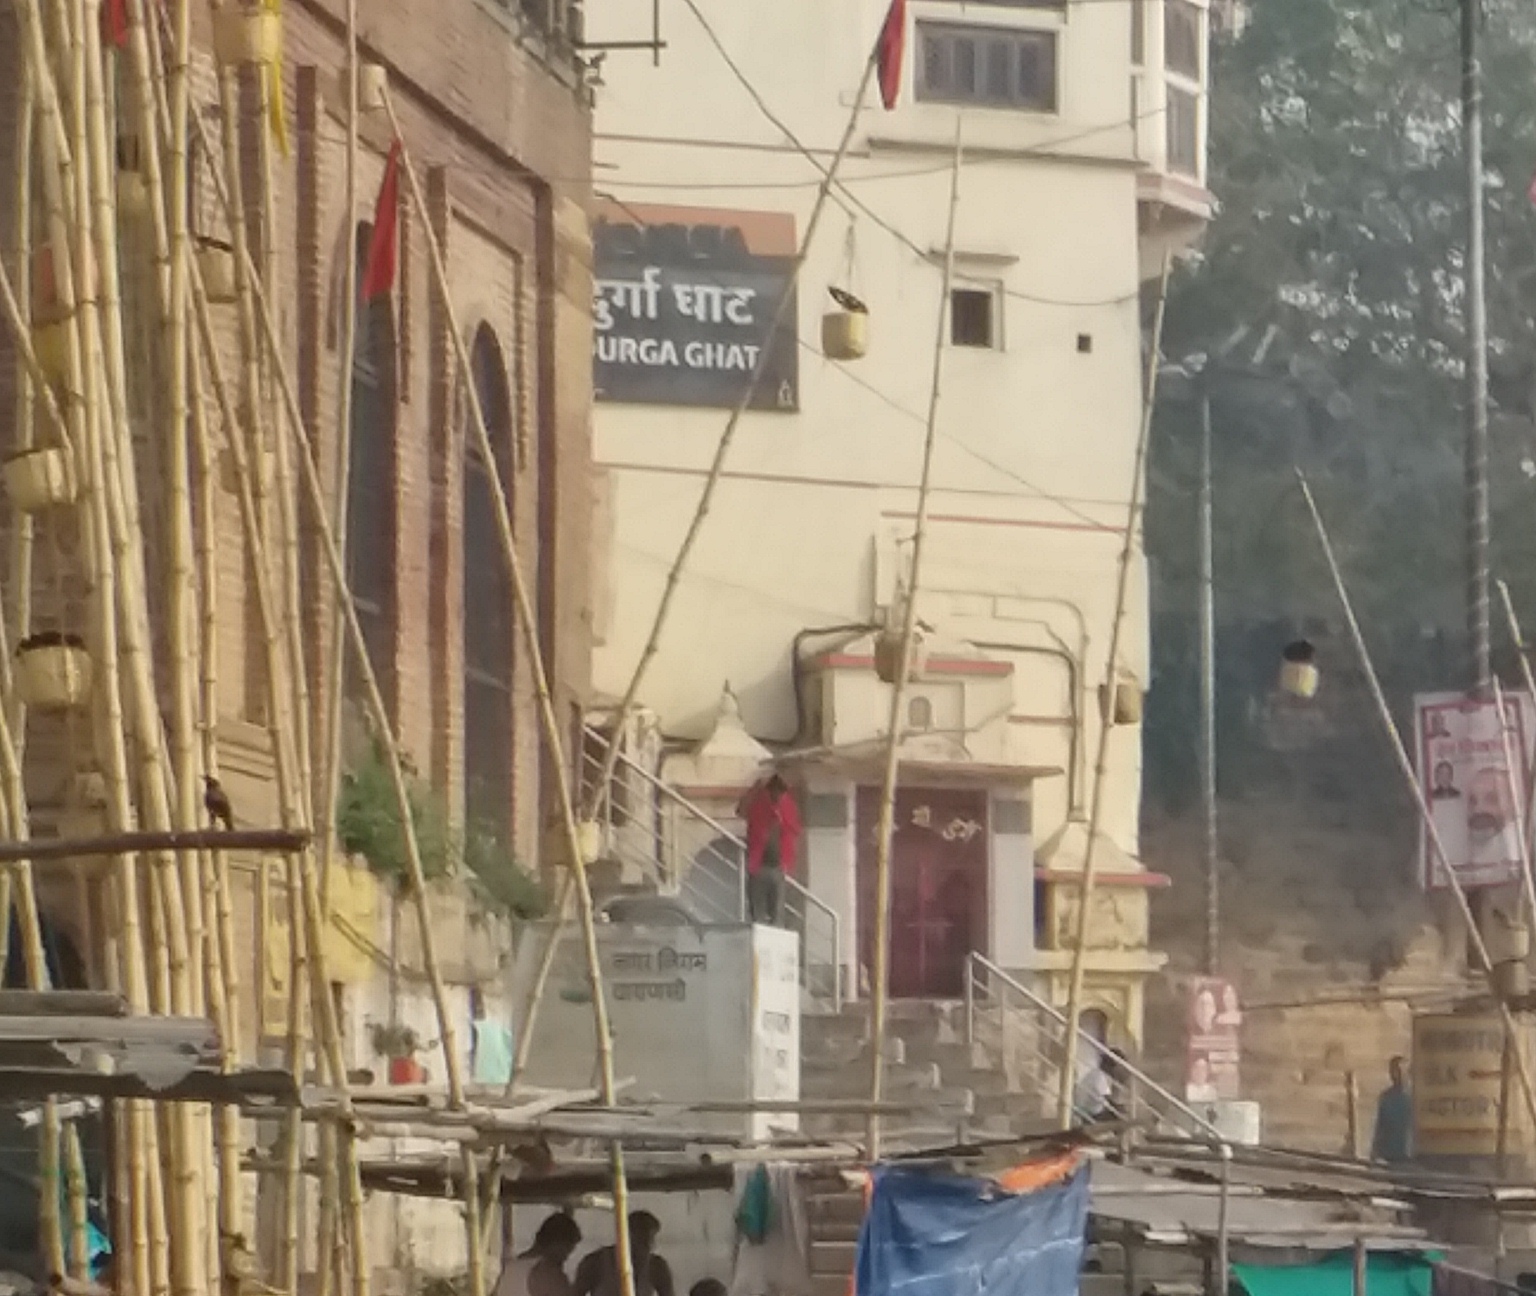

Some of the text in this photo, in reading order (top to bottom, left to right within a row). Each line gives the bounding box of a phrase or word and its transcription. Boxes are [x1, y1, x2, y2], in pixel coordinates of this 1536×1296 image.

[672, 283, 756, 325] घाट
[594, 335, 760, 370] URGA GHAT
